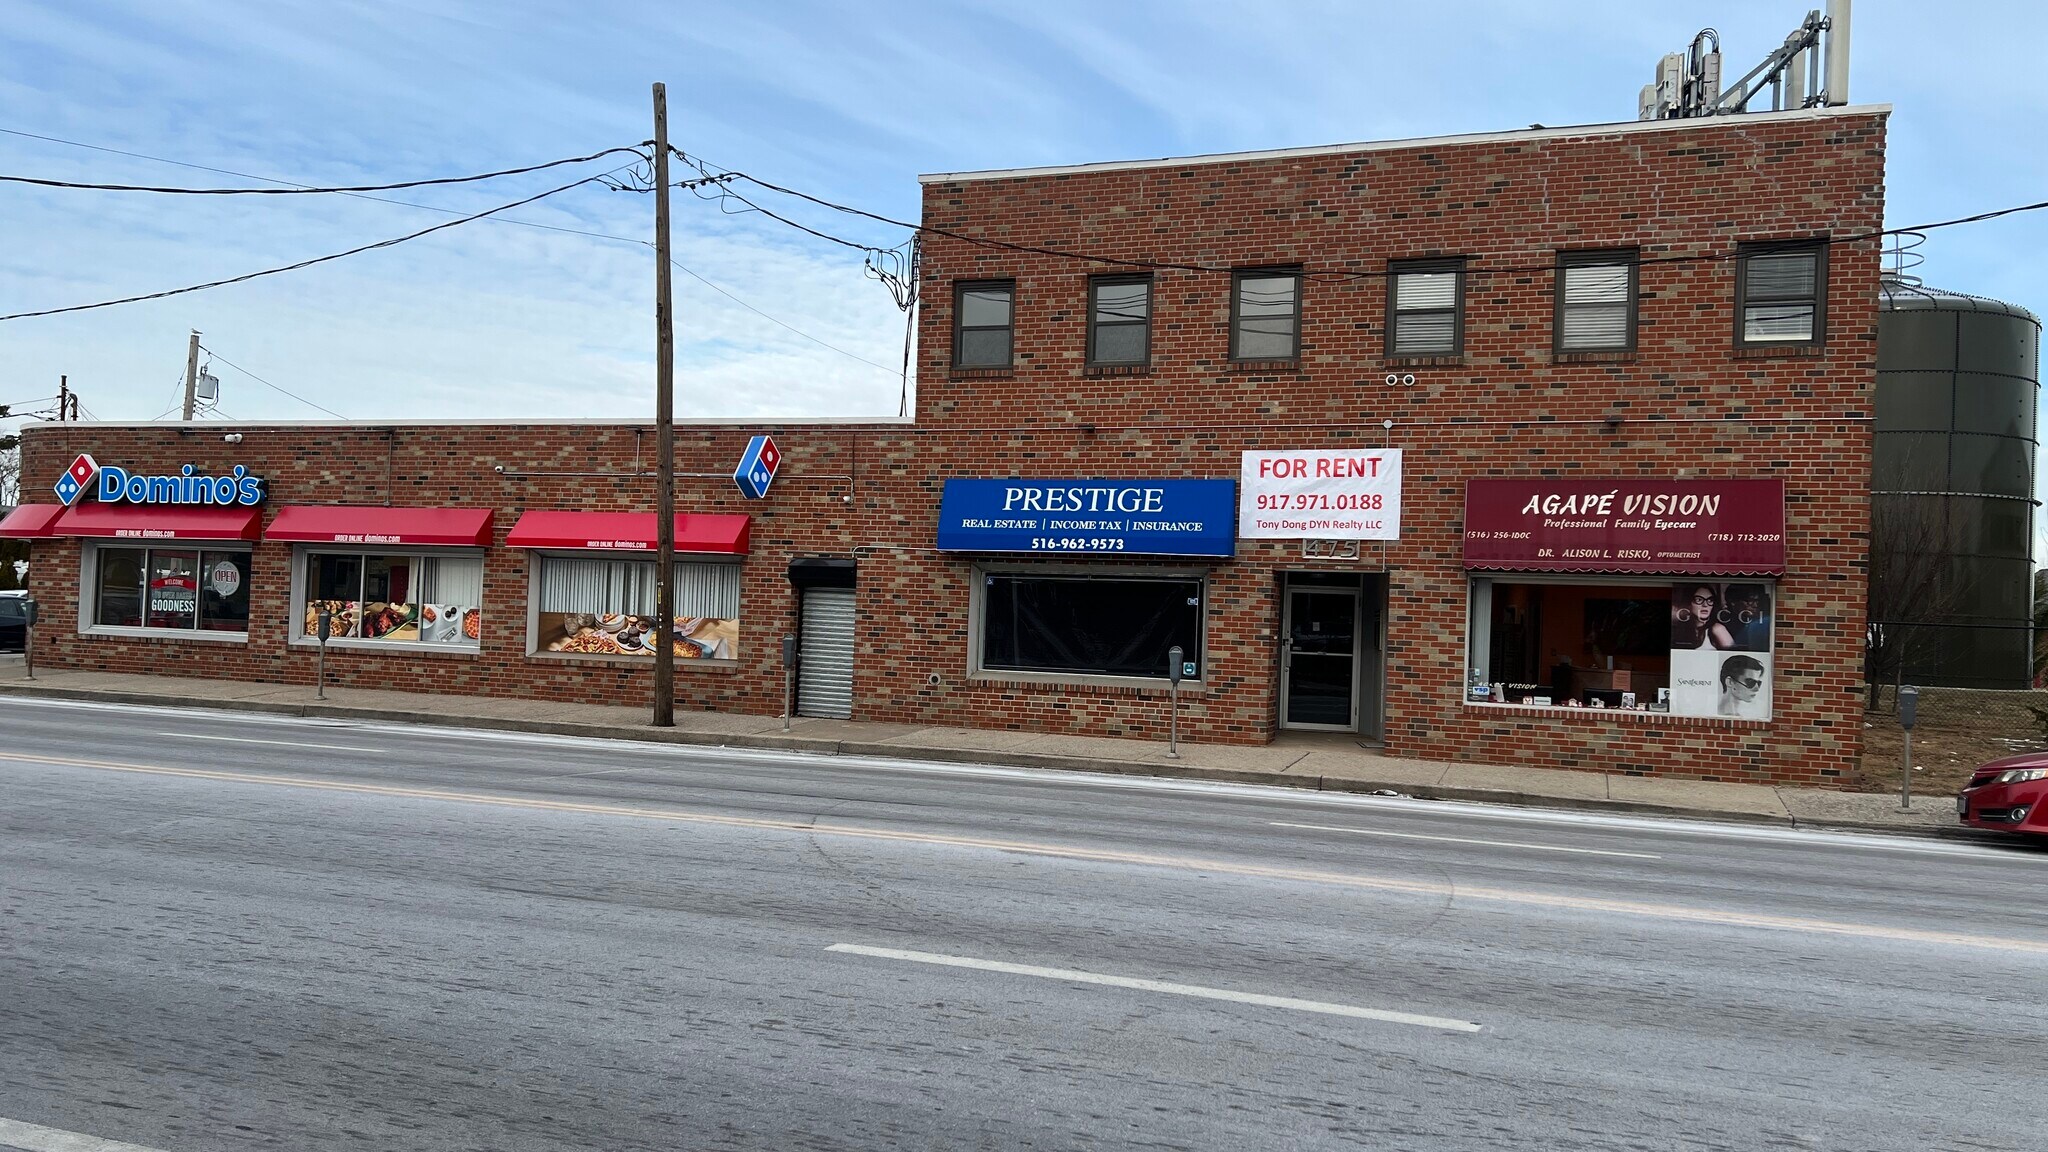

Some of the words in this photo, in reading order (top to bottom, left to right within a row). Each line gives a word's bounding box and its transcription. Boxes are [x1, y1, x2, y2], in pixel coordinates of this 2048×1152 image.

[1259, 458, 1308, 479] FOR
[1315, 457, 1383, 478] RENT
[98, 464, 263, 506] Domino's
[1001, 487, 1164, 513] PRESTIGE
[1257, 494, 1383, 511] 917.971.0188
[1521, 489, 1619, 515] AGAPÉ
[1623, 493, 1721, 516] VISION
[961, 518, 992, 529] REAL
[993, 519, 1037, 530] ESTATE
[1049, 519, 1097, 531] INCOME
[1098, 520, 1122, 531] TAX
[1132, 521, 1203, 532] INSURANCE
[1256, 519, 1280, 531] Tony
[1282, 519, 1307, 531] Dong
[1309, 520, 1330, 530] DYN
[1332, 520, 1363, 531] Realty
[1365, 520, 1382, 530] LLC
[1544, 518, 1608, 530] Professional
[1614, 519, 1651, 531] Family
[1654, 519, 1697, 531] Eyecare
[1466, 531, 1490, 540] (516)
[1707, 533, 1734, 543] (718)
[1737, 534, 1781, 542] 712-2020
[1031, 538, 1124, 550] 516-962-9573
[1304, 539, 1357, 558] 475
[1537, 548, 1555, 558] DR.
[1562, 549, 1601, 559] ALISON
[1603, 550, 1612, 559] L.
[1617, 549, 1652, 561] RISKO,
[214, 569, 237, 583] OPEN
[151, 599, 195, 613] GOODNESS
